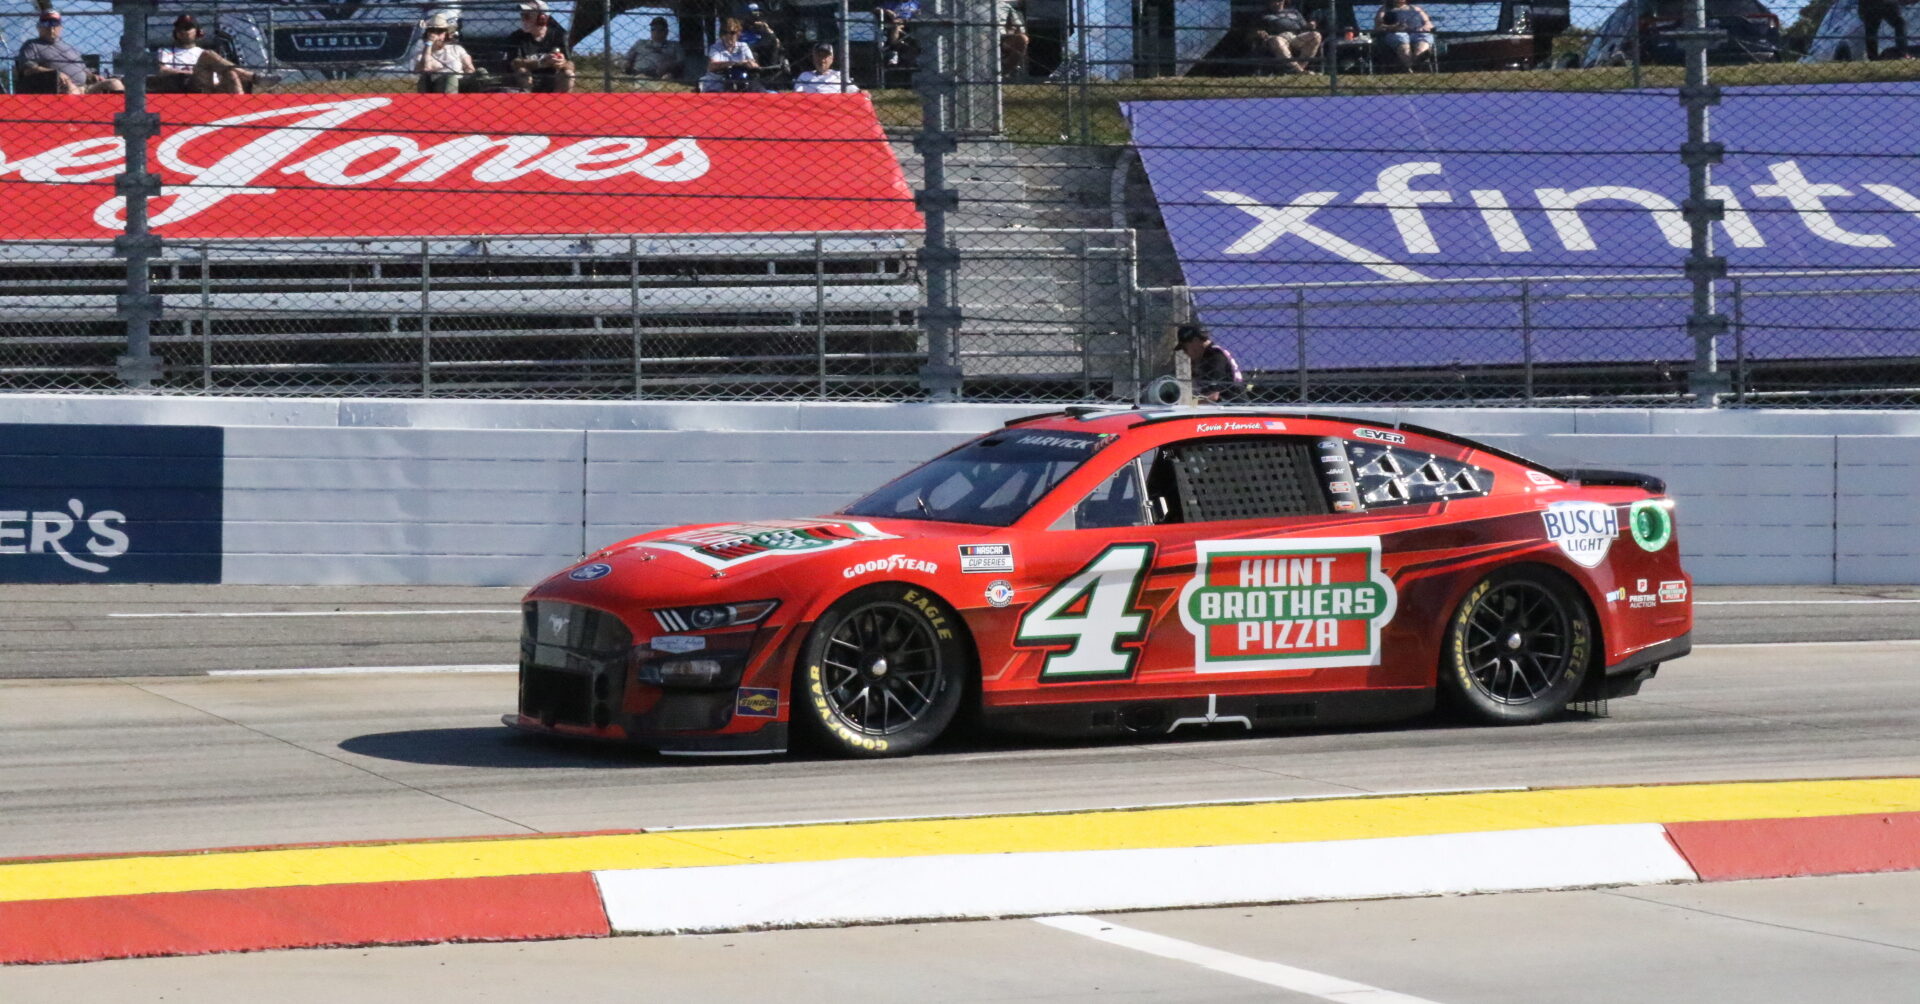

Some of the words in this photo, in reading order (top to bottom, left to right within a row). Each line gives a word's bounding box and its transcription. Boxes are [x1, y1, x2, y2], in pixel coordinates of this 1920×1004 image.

[93, 97, 710, 231] Jones
[1016, 435, 1094, 449] HARVICK
[1196, 423, 1222, 433] Kevin
[0, 498, 130, 573] ER'S
[1543, 509, 1617, 539] BUSCH
[976, 545, 1004, 555] NASCAR
[1567, 538, 1604, 552] LIGHT
[842, 554, 938, 579] GOODYEAR
[968, 558, 983, 567] CUP
[983, 558, 1006, 567] SERIES
[1239, 557, 1337, 588] HUNT
[903, 589, 953, 641] EAGLE
[1016, 544, 1152, 681] 4
[1200, 587, 1376, 620] BROTHERS
[1238, 618, 1338, 650] PIZZA
[1564, 619, 1590, 681] EAGLE
[740, 697, 777, 707] SUNOCO
[810, 665, 889, 751] GOODYEAR
